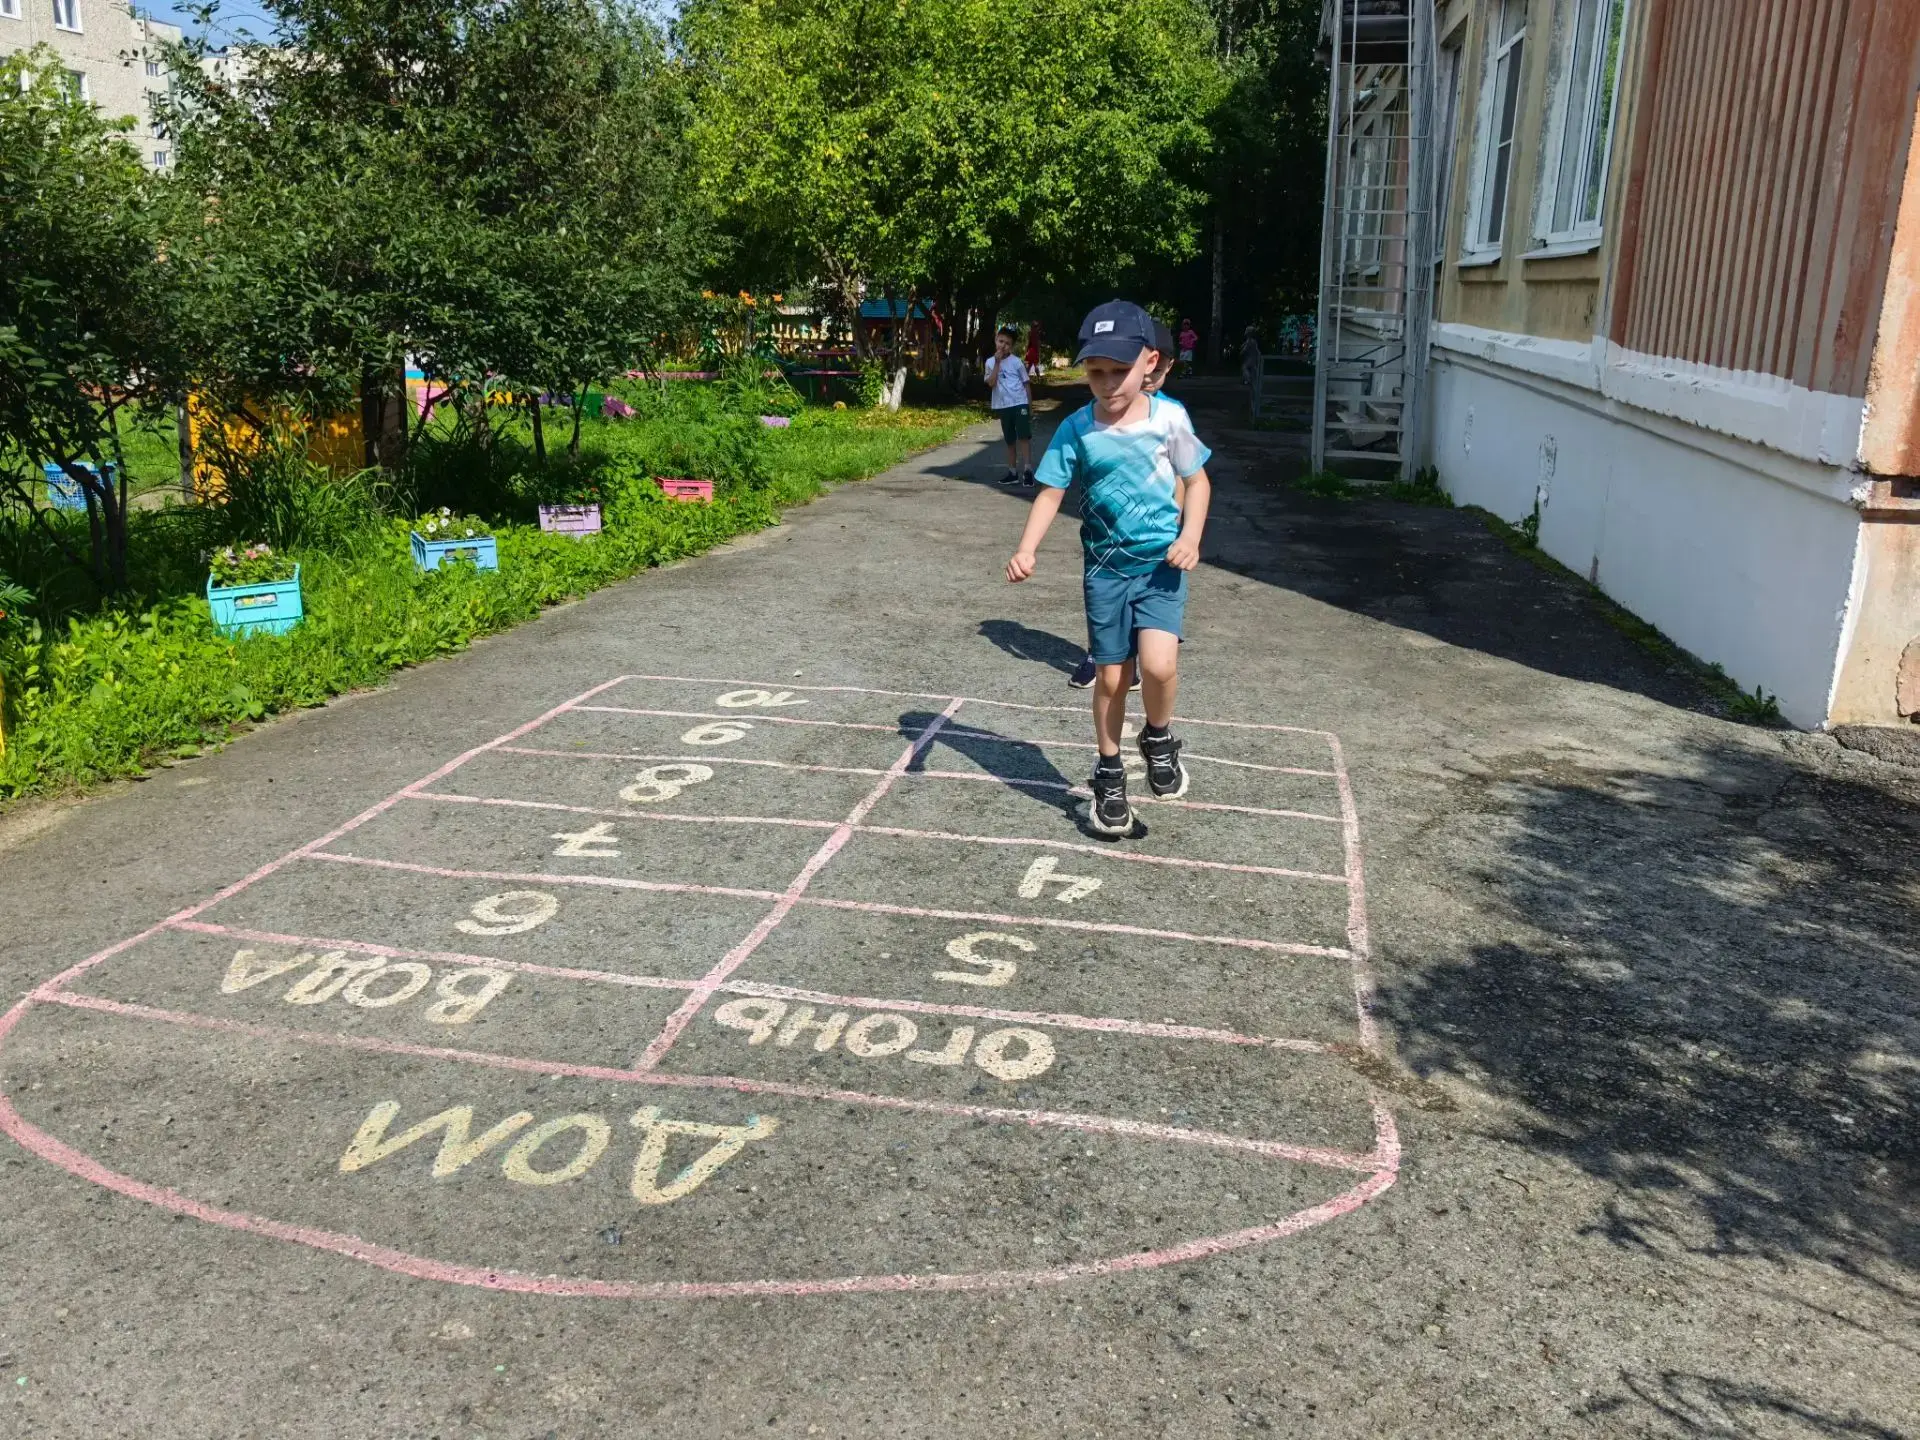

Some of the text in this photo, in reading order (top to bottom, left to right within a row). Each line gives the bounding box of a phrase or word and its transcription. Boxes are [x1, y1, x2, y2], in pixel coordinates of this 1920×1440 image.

[714, 689, 810, 708] 10
[680, 722, 755, 746] 9
[618, 763, 714, 802] 8
[551, 821, 622, 857] 7
[1017, 856, 1102, 903] 4
[454, 890, 560, 936] 6
[932, 931, 1036, 987] 5
[220, 949, 513, 1025] ВОДА
[714, 997, 1056, 1081] ОГОНЬ
[338, 1100, 778, 1204] ДОМ
